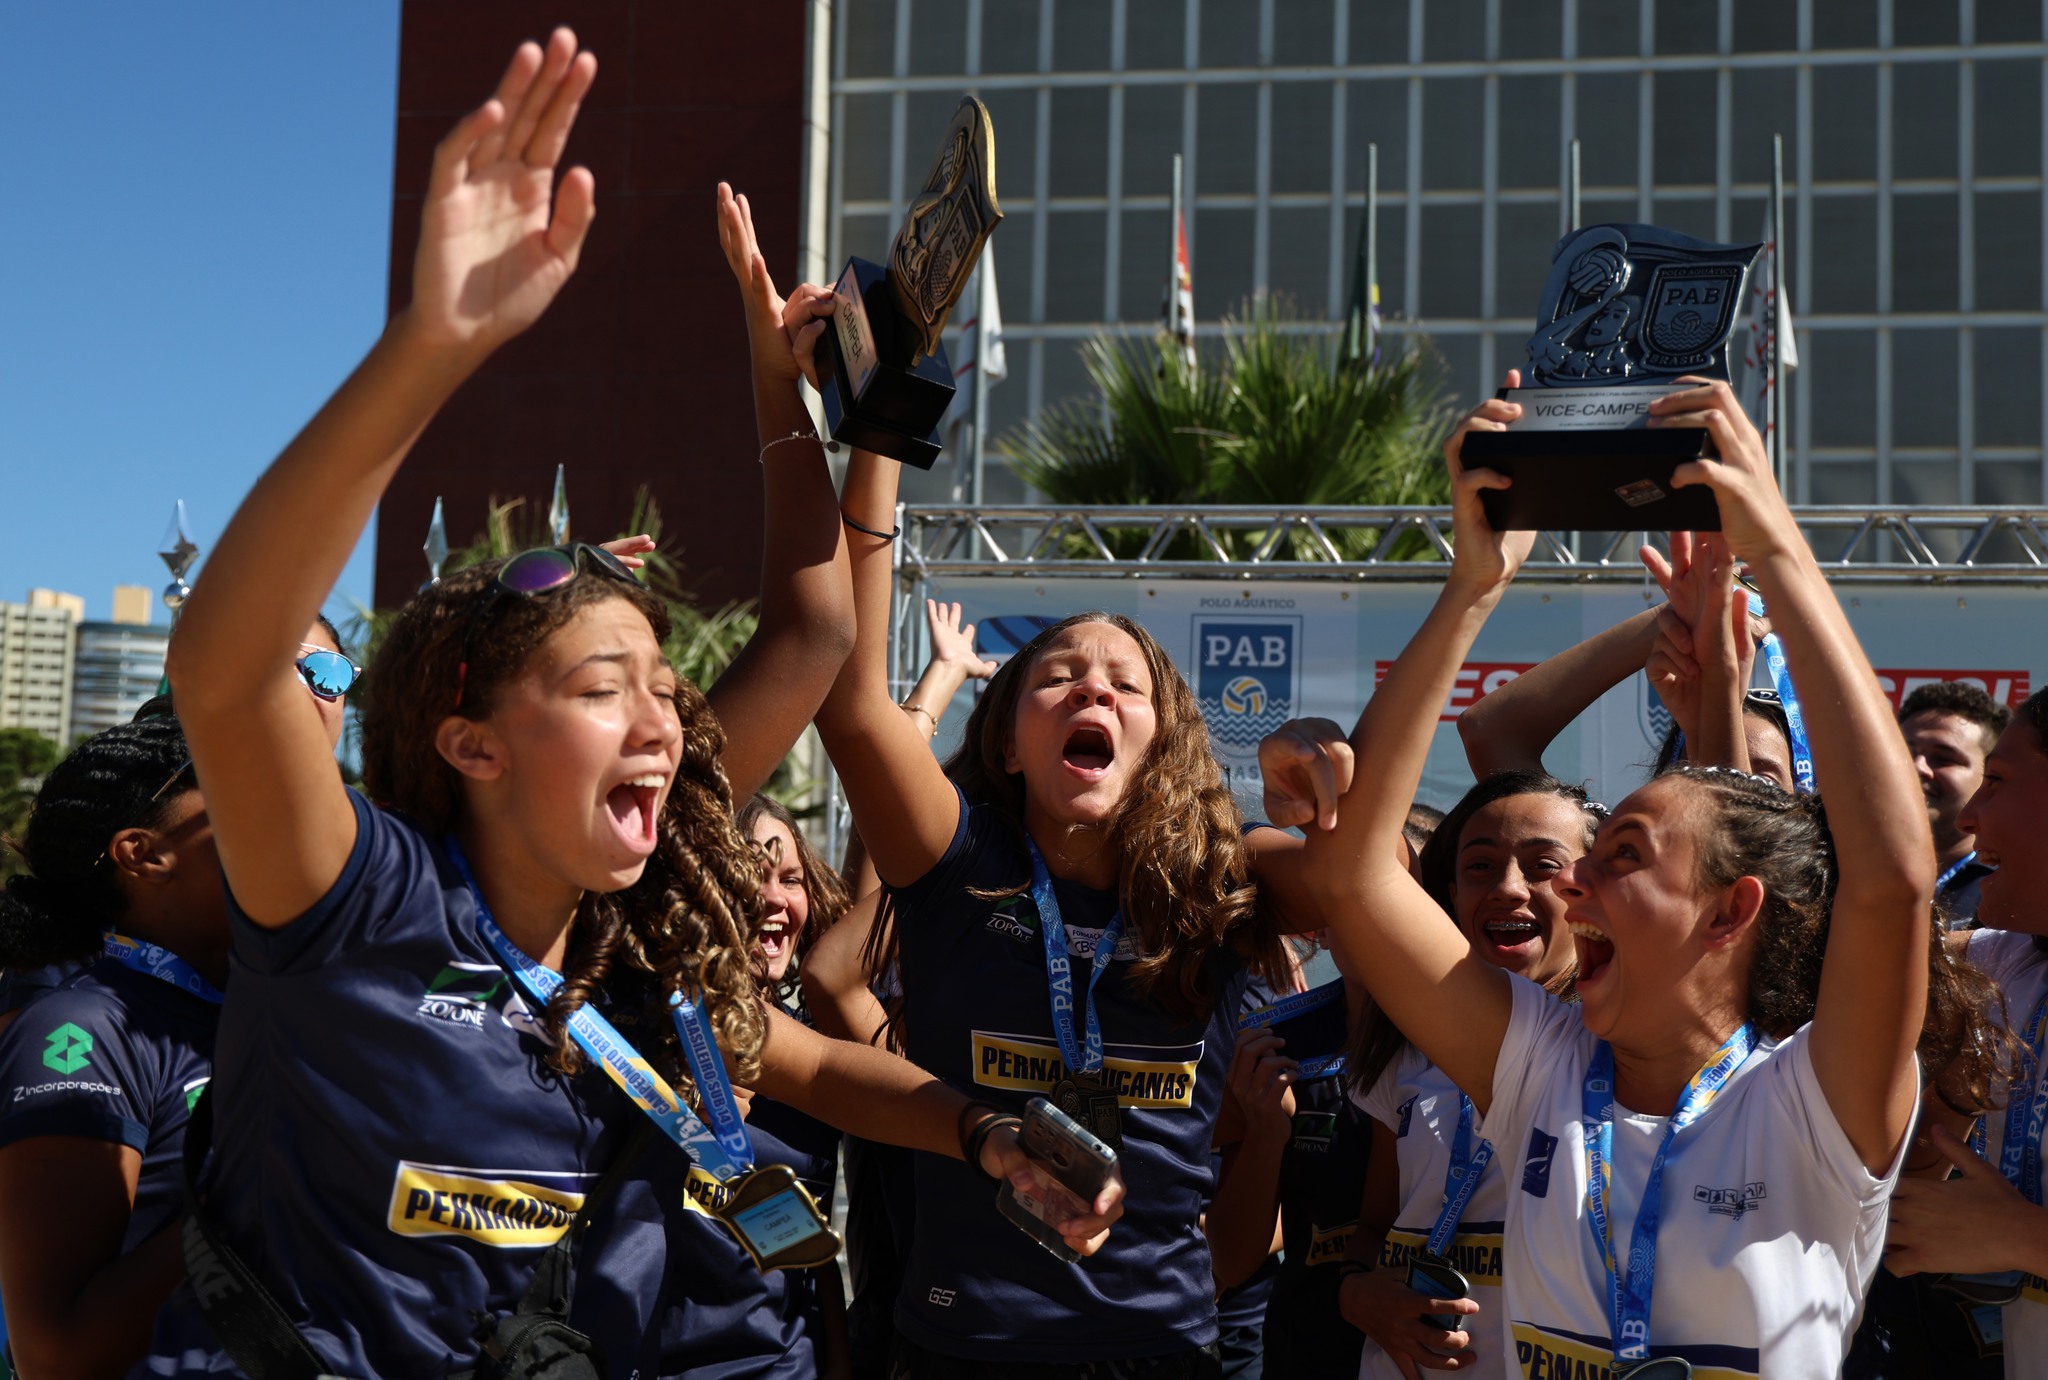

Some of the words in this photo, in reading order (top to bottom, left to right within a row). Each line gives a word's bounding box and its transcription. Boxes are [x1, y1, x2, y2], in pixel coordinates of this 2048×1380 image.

[1664, 287, 1720, 306] PAB
[842, 302, 863, 363] CAMPEÃ
[1649, 354, 1705, 366] BRASIL
[1535, 402, 1651, 417] VICE-CAMPE
[1200, 598, 1232, 608] POLO
[1234, 597, 1296, 609] AQUÁTICO
[1205, 635, 1287, 667] PAB
[1050, 957, 1073, 1012] PAB
[1059, 1018, 1070, 1030] 14
[683, 1010, 716, 1081] BRASILEIRO
[1063, 1031, 1077, 1053] SUB
[605, 1051, 671, 1117] CAMPEONATO
[1689, 1049, 1740, 1100] CAMPEONATO
[708, 1080, 727, 1109] SUB
[716, 1106, 733, 1125] 14
[1097, 1104, 1117, 1118] PAB
[2013, 1102, 2025, 1125] SUB
[2011, 1125, 2022, 1139] 14
[1590, 1151, 1607, 1229] CAMPEONATO
[1433, 1200, 1462, 1250] BRASILEIRO
[1458, 1181, 1472, 1201] SUB
[1468, 1170, 1478, 1183] 14
[182, 1215, 243, 1311] NIKE
[928, 1286, 956, 1307] GS
